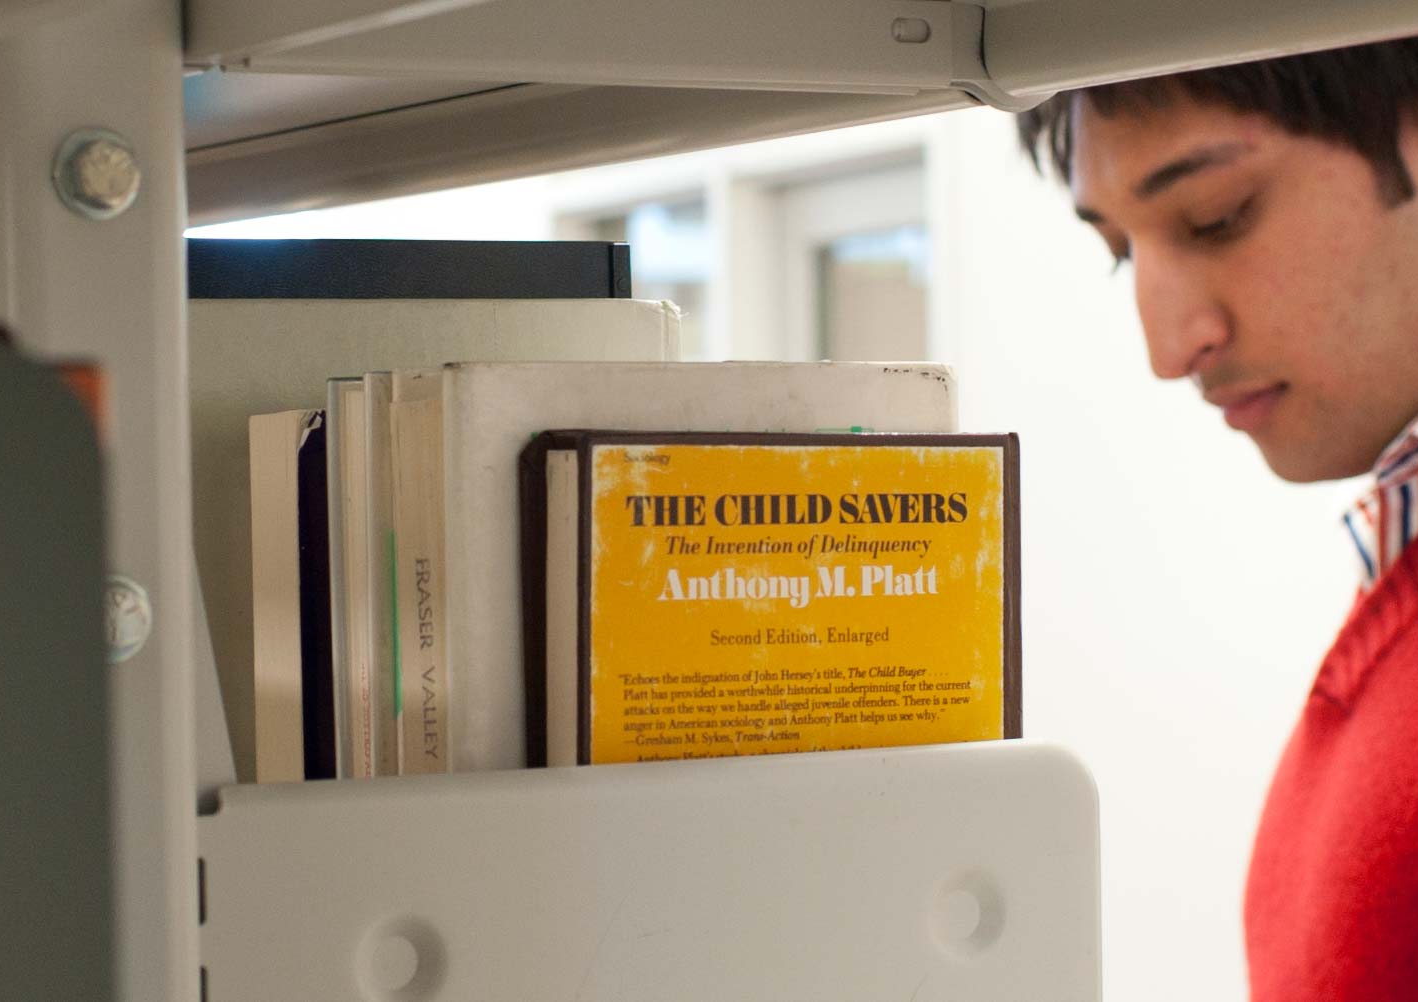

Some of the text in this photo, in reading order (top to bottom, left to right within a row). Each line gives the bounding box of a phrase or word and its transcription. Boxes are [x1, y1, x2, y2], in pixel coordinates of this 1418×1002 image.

[625, 491, 969, 528] THE CHILD SAVERS
[665, 533, 933, 559] The Invention of Delinquency
[656, 564, 940, 609] Anthony M. Platt
[710, 626, 891, 648] Second Edition, Enlarged
[415, 557, 440, 760] FRASER VALLEY
[662, 671, 679, 685] the
[681, 671, 740, 687] indignation
[742, 669, 752, 682] of
[753, 670, 779, 684] John
[781, 668, 822, 683] Hersey's
[822, 668, 846, 681] title,
[847, 666, 868, 679] The
[868, 665, 897, 678] Child
[898, 665, 927, 680] Buyer
[623, 680, 971, 703] Platt has provided a worthwhile historical underpinning for the current
[624, 694, 971, 716] attacks on the way we handle alleged juvenile offenders. There is a new
[623, 721, 652, 733] anger
[655, 719, 666, 730] in
[669, 718, 718, 730] American
[719, 715, 765, 730] sociology
[768, 716, 788, 726] and
[789, 713, 832, 727] Anthony
[834, 711, 858, 724] Platt
[860, 711, 886, 725] helps
[887, 713, 898, 722] us
[899, 712, 915, 722] see
[701, 731, 734, 746] Sykes,
[735, 729, 801, 743] Trans-Action
